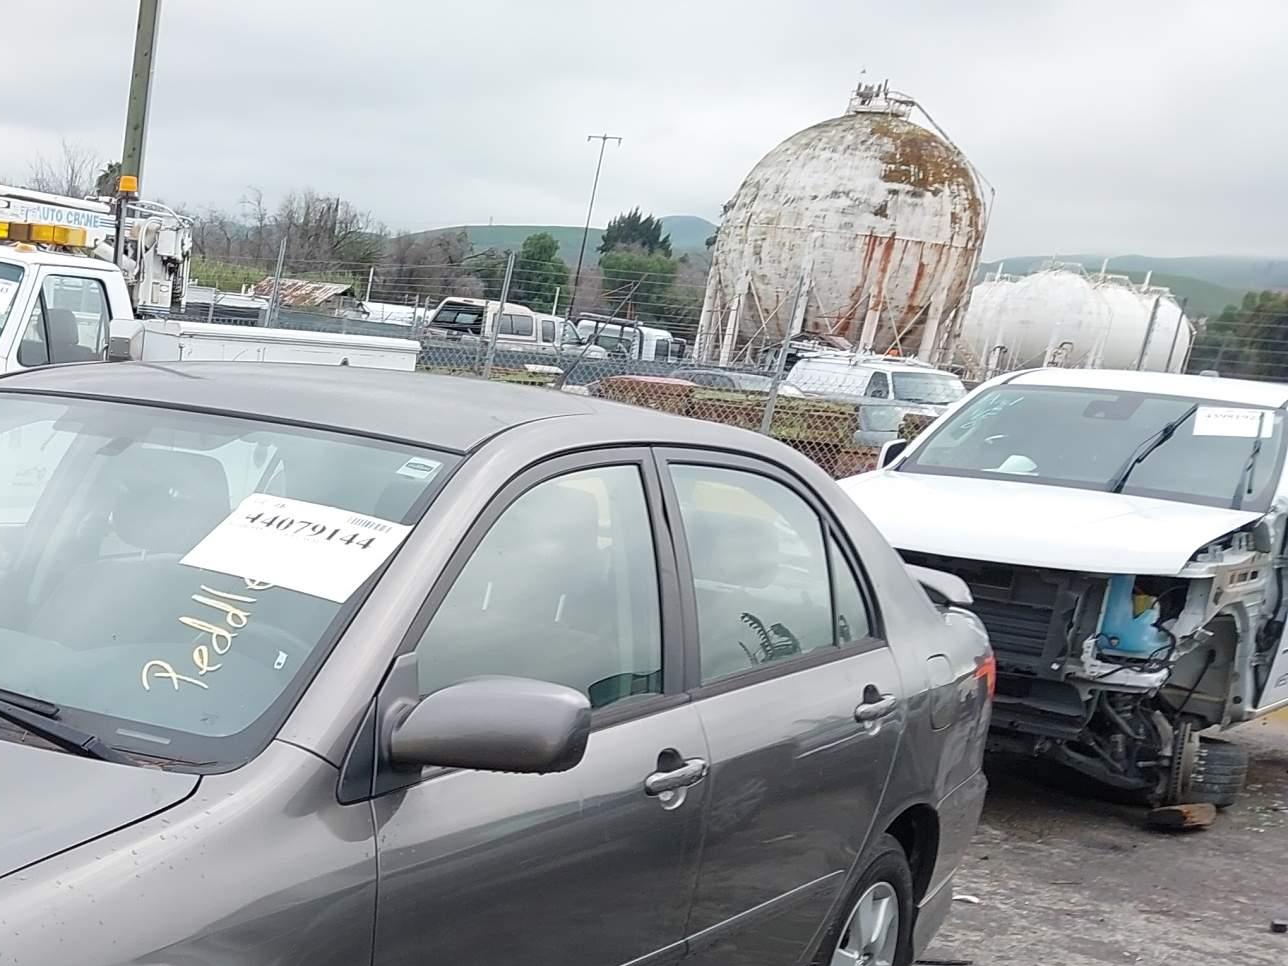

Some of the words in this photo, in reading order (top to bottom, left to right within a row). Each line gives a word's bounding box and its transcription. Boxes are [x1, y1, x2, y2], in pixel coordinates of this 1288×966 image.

[38, 206, 63, 222] AUTO
[66, 211, 100, 229] CRANE
[245, 512, 376, 550] 44079144
